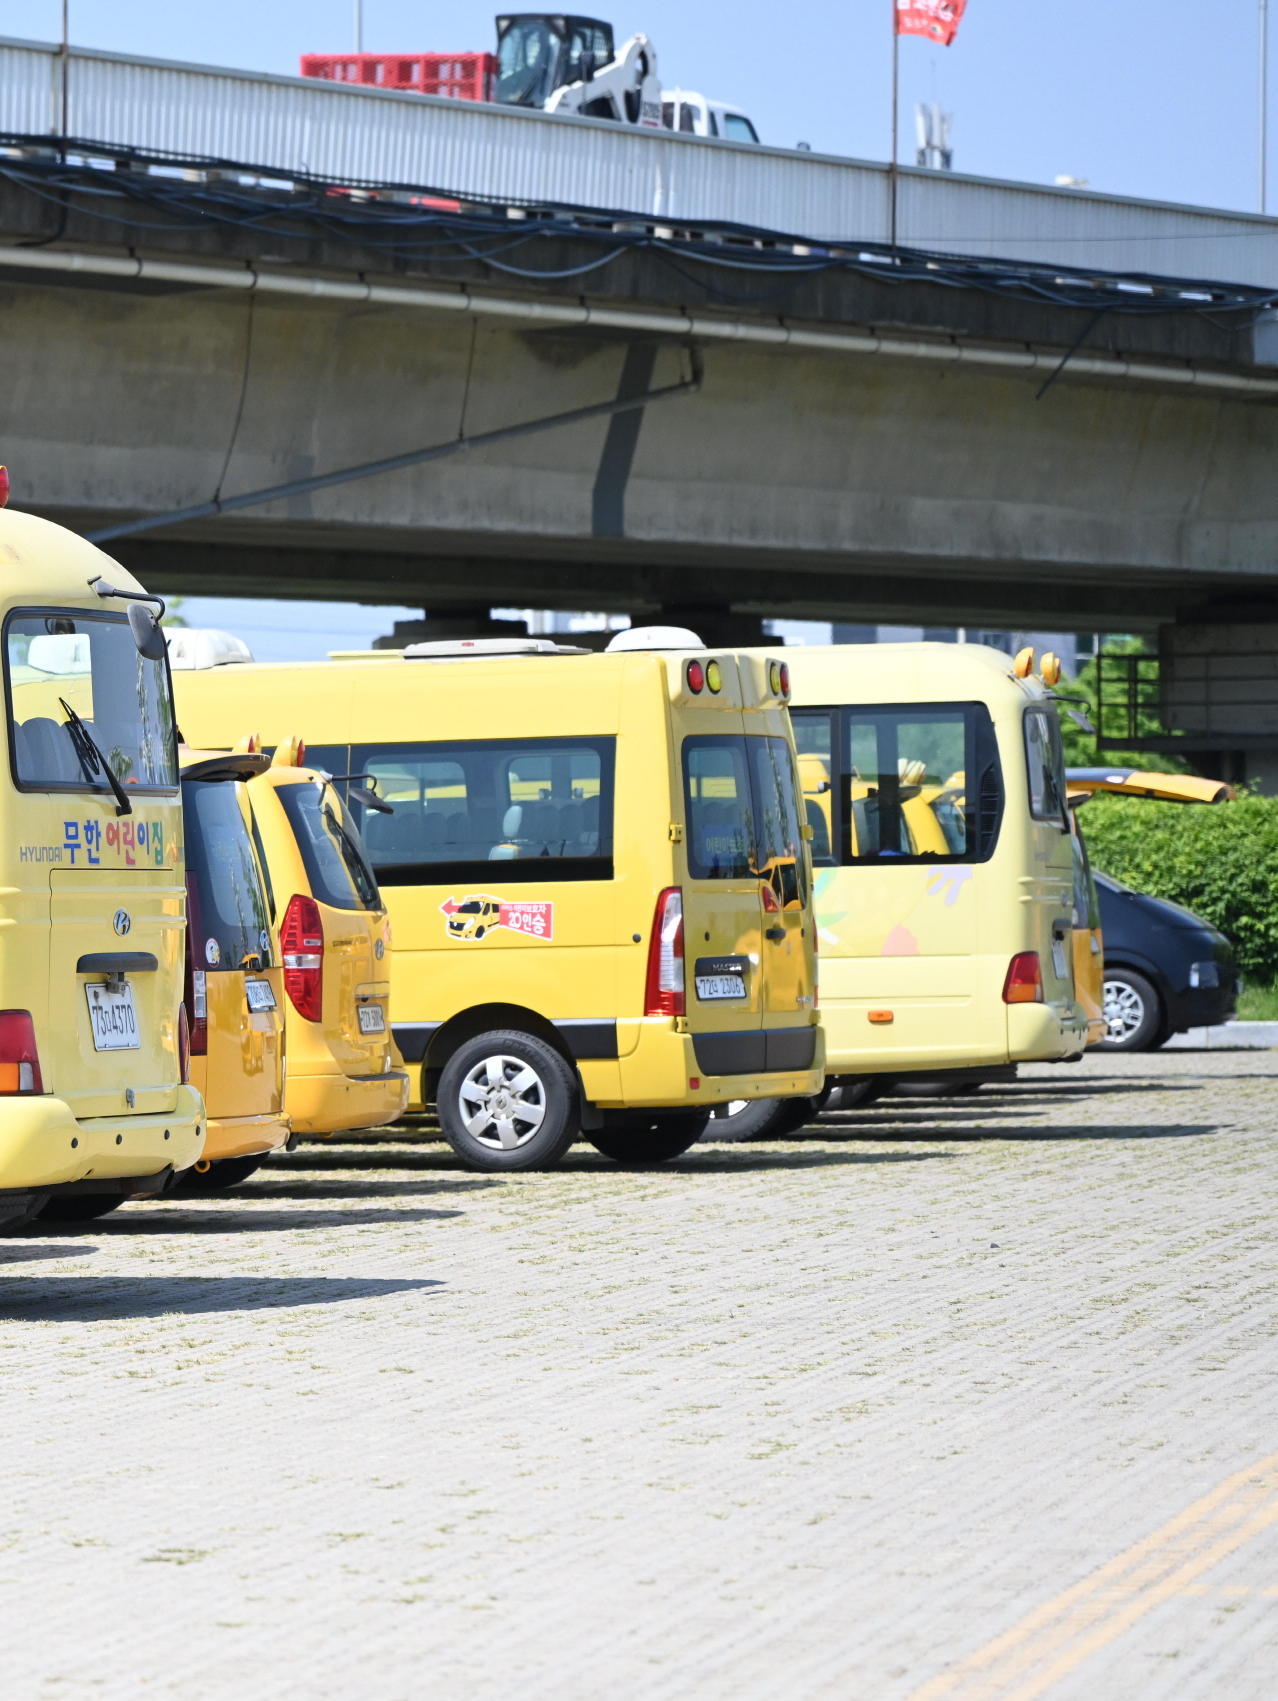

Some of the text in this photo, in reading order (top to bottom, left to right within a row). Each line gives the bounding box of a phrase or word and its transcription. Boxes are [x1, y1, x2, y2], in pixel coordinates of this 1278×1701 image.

[63, 819, 164, 866] 무한 어린이집
[20, 846, 63, 863] HYUNDAI
[508, 911, 547, 935] 20인승
[712, 963, 742, 972] MASTER
